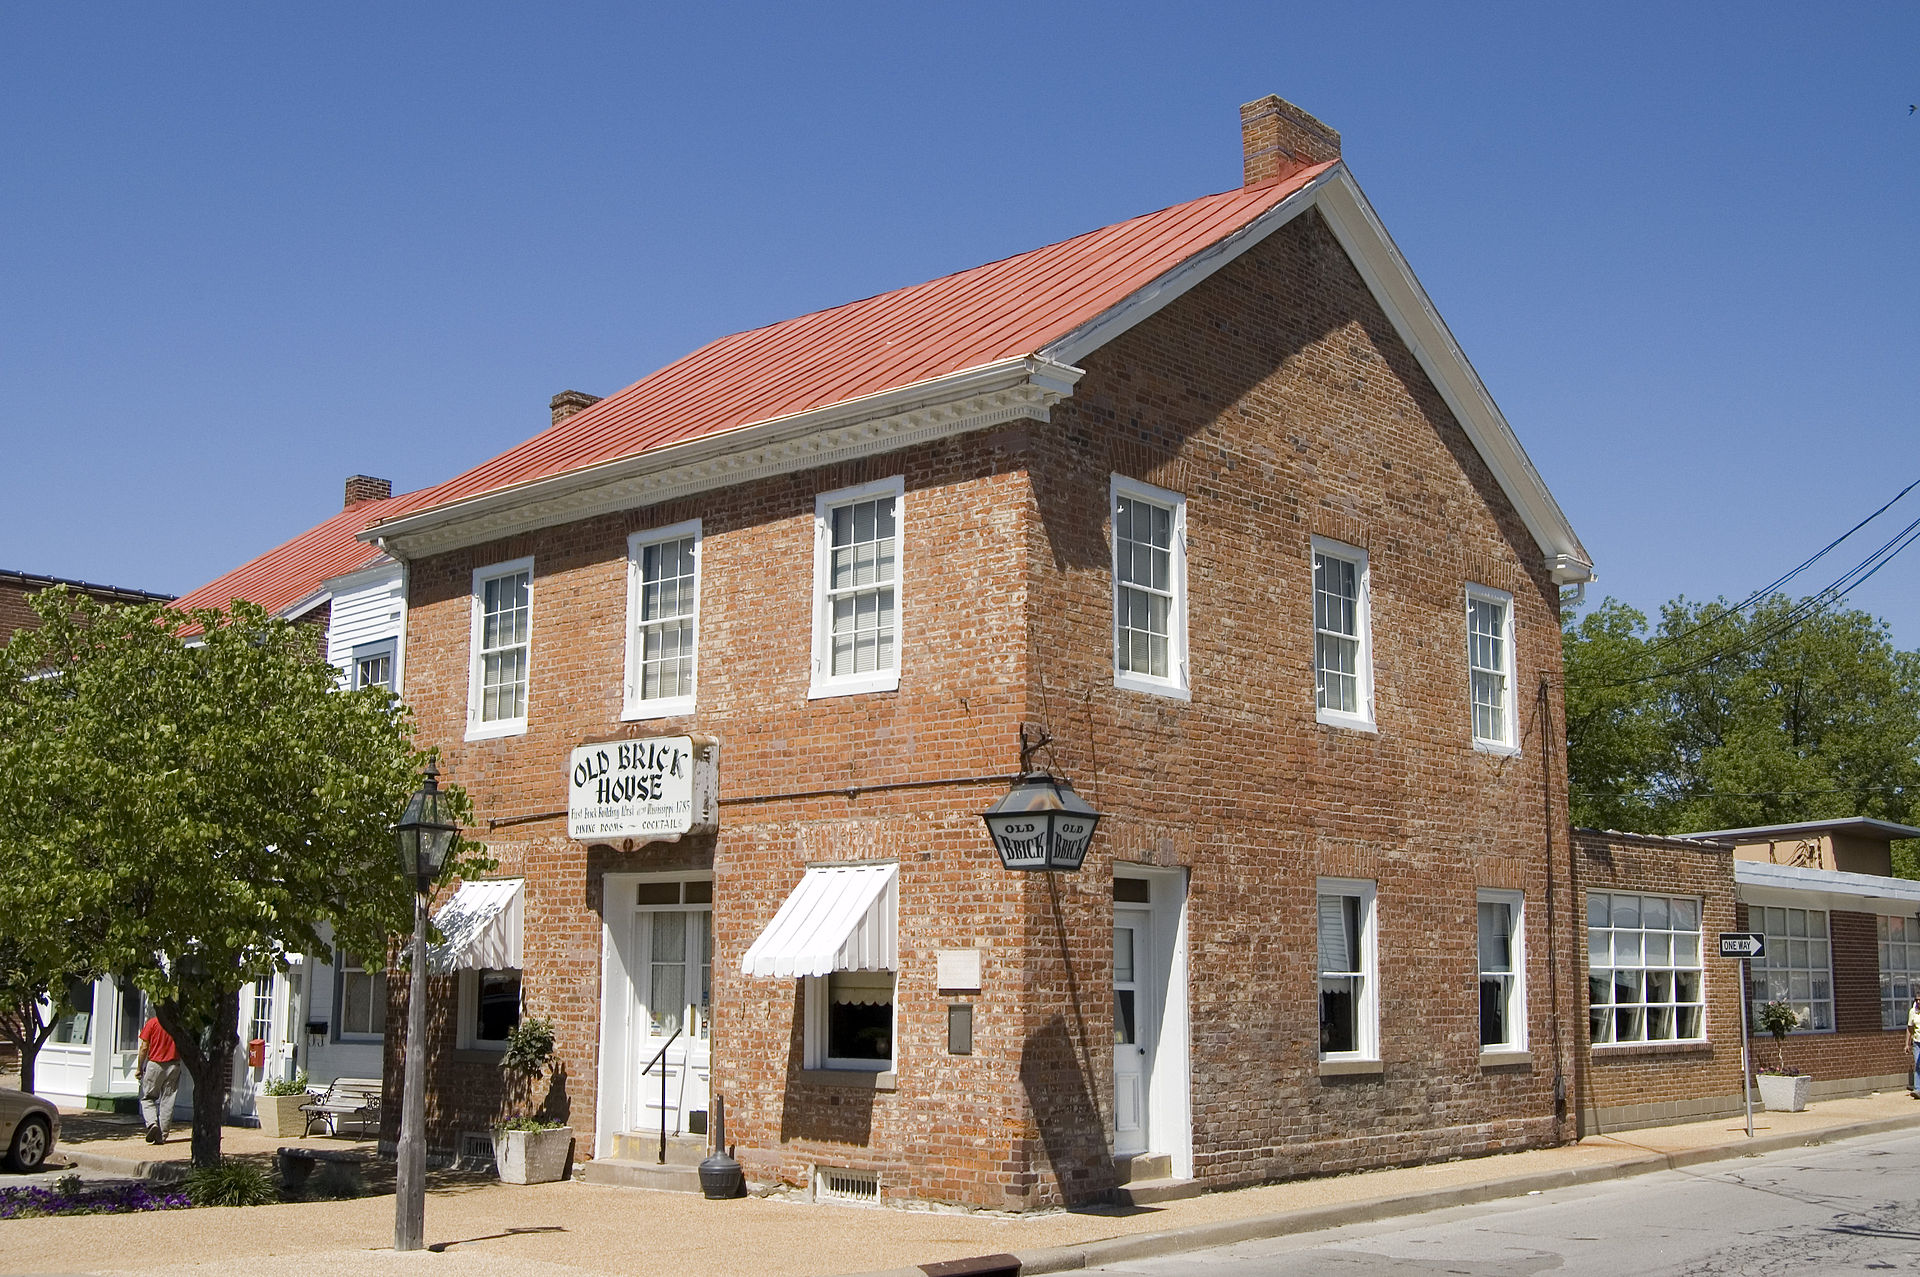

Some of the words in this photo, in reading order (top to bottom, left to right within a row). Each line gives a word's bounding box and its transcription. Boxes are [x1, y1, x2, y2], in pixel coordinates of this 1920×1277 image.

[574, 749, 610, 788] OLD
[617, 742, 688, 779] BRICK
[596, 774, 663, 804] HOUSE
[575, 824, 595, 834] DINING
[600, 822, 624, 832] ROOMS
[642, 819, 683, 830] COCKTAILS
[1005, 824, 1035, 833] OLD
[1063, 824, 1084, 833] OLD
[998, 832, 1046, 860] BRICK
[1054, 832, 1088, 860] BRICK
[1724, 941, 1737, 950] ONE
[1738, 941, 1751, 950] WAY
